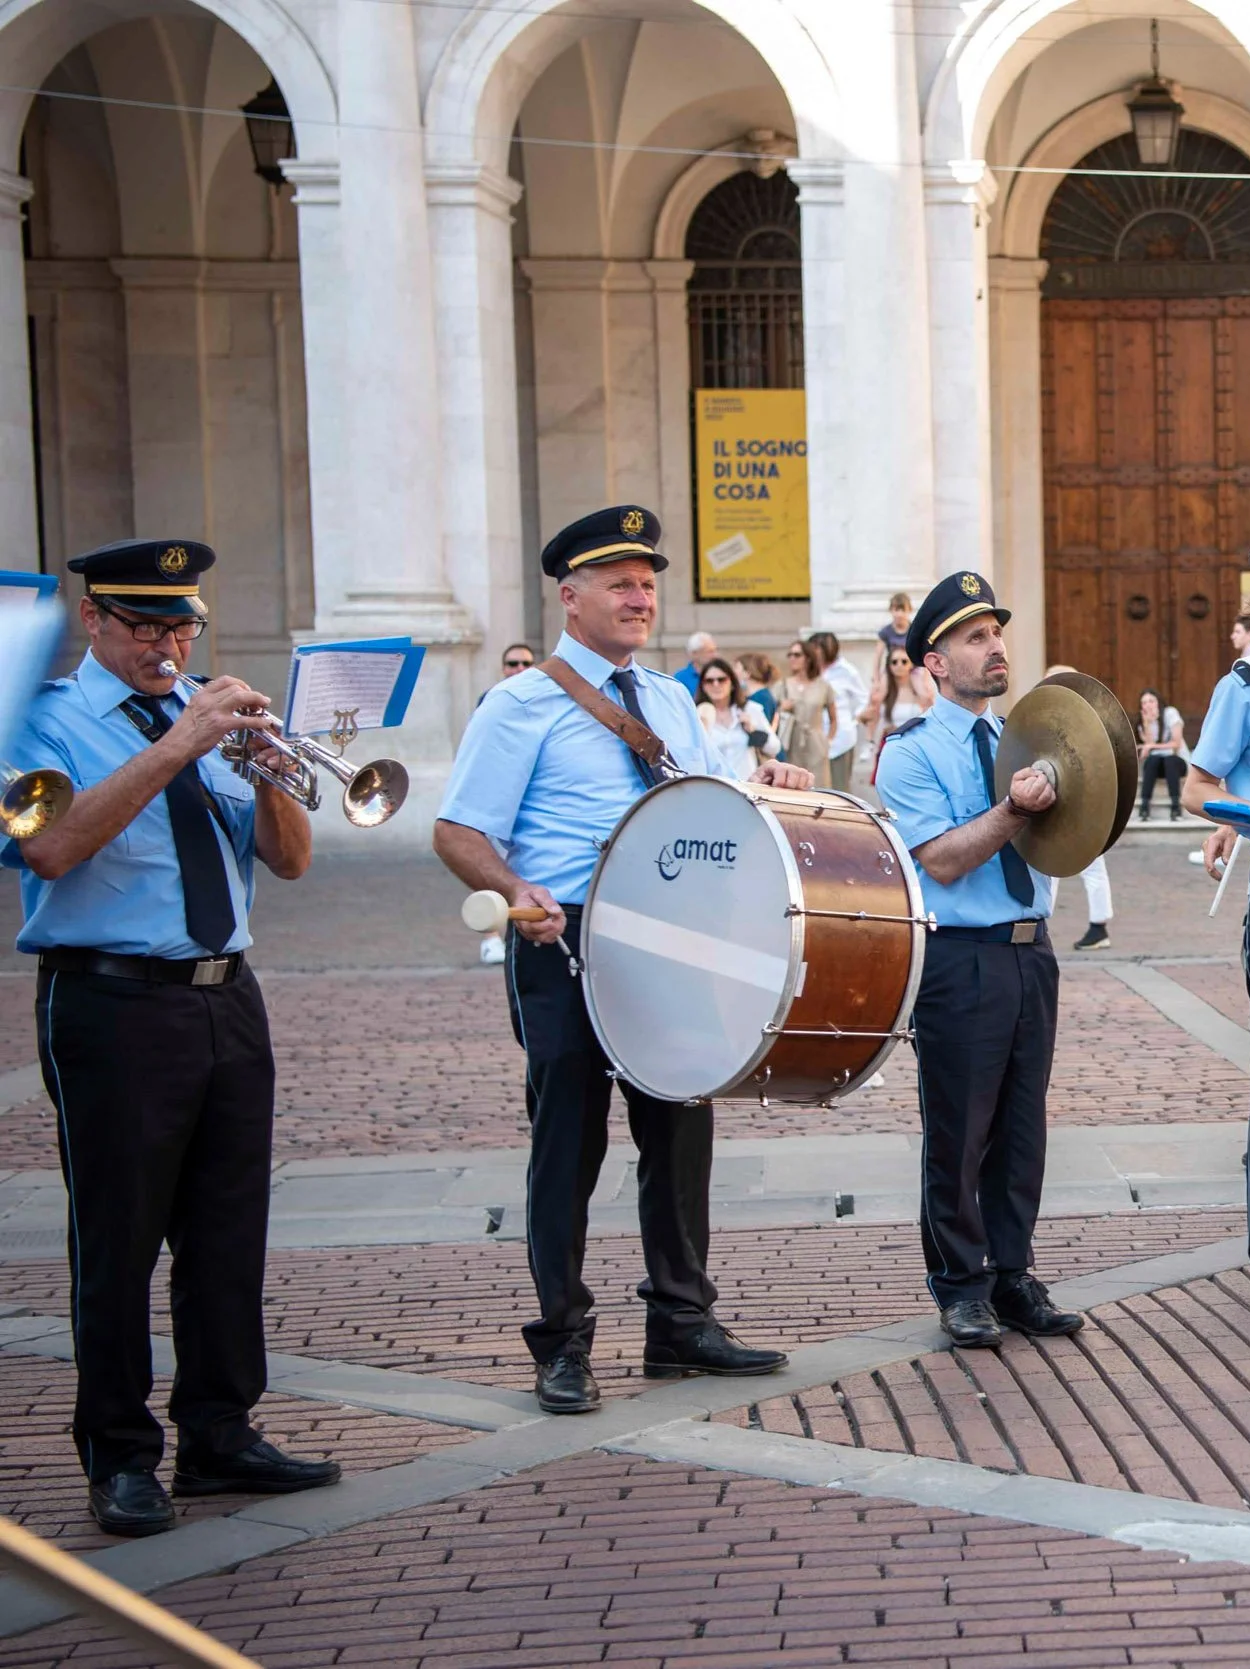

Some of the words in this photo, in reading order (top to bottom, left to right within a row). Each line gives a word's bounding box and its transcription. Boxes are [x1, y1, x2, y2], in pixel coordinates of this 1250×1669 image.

[714, 440, 730, 457] IL
[736, 439, 807, 457] SOGNO
[714, 462, 731, 478] DI
[737, 462, 780, 478] UNA
[714, 483, 770, 500] COSA
[674, 838, 737, 862] amat
